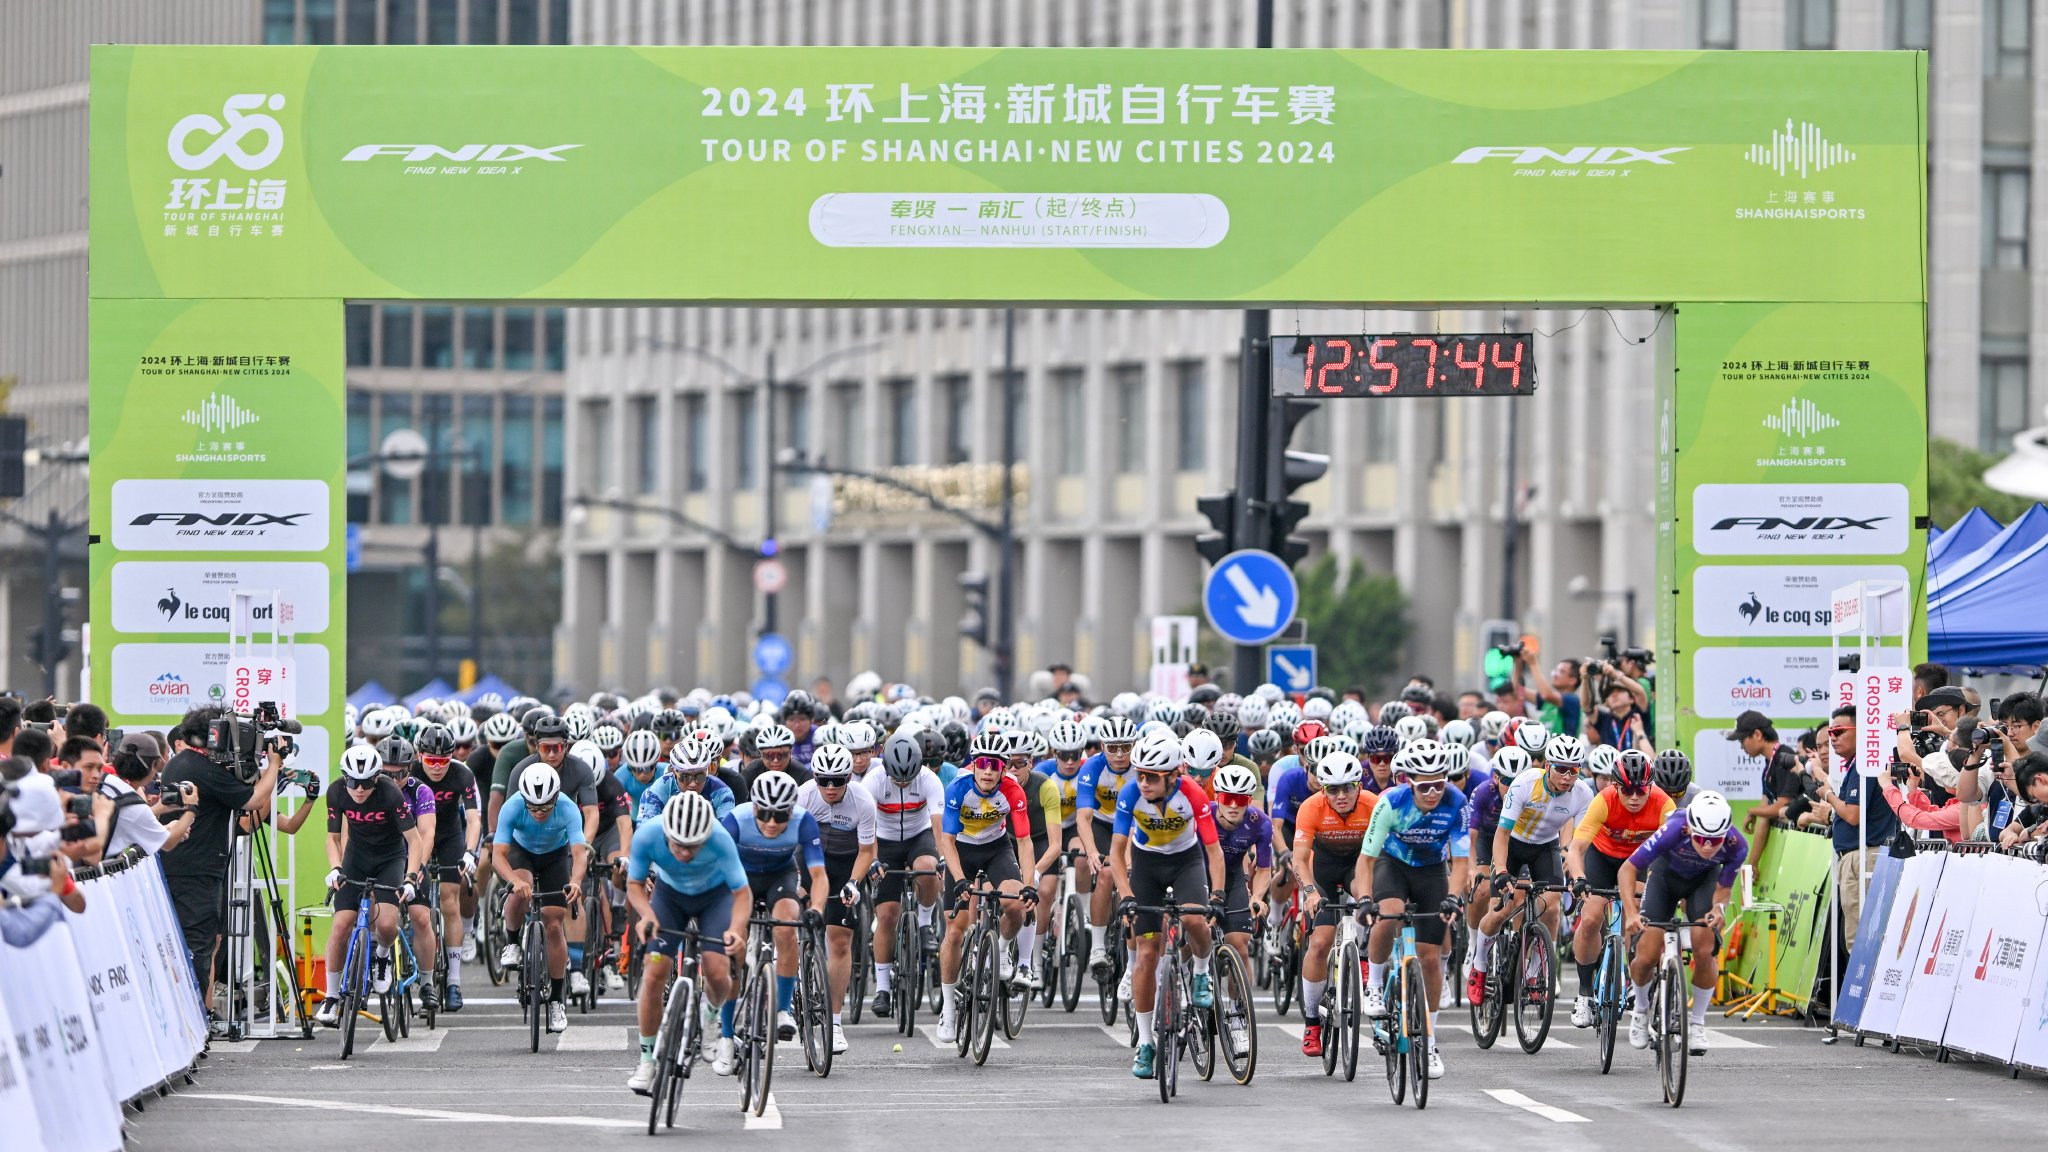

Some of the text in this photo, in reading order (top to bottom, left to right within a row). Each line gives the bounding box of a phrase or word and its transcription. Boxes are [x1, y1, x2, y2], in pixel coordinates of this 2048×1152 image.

[702, 83, 1335, 124] 2024 环上海·新城自行车赛
[341, 144, 585, 161] FNIX
[701, 139, 790, 161] TOUR
[806, 139, 846, 161] OF
[1136, 140, 1243, 163] CITIES
[1258, 141, 1334, 163] 2024
[1451, 147, 1693, 164] FNIX
[165, 179, 287, 209] 环上海
[1766, 190, 1835, 203] 上海赛事
[164, 213, 194, 221] TOUR
[201, 213, 214, 221] OF
[1736, 208, 1865, 219] SHANGHAISPORTS
[165, 225, 283, 236] 新城自行车赛
[981, 226, 1034, 235] NANHUI
[1042, 226, 1146, 236] (START/FINISH)
[1305, 339, 1524, 393] 12:57:44
[197, 441, 245, 451] 上海赛事
[1778, 446, 1825, 456] 上海赛事
[129, 513, 313, 525] FNIX
[1710, 517, 1892, 530] FNIX
[185, 603, 229, 622] le coq
[1766, 607, 1779, 622] le
[1784, 611, 1810, 625] coq
[149, 682, 190, 695] evian
[1731, 685, 1772, 699] evian
[1867, 676, 1880, 767] CROSS HERE
[345, 810, 385, 821] DLCC
